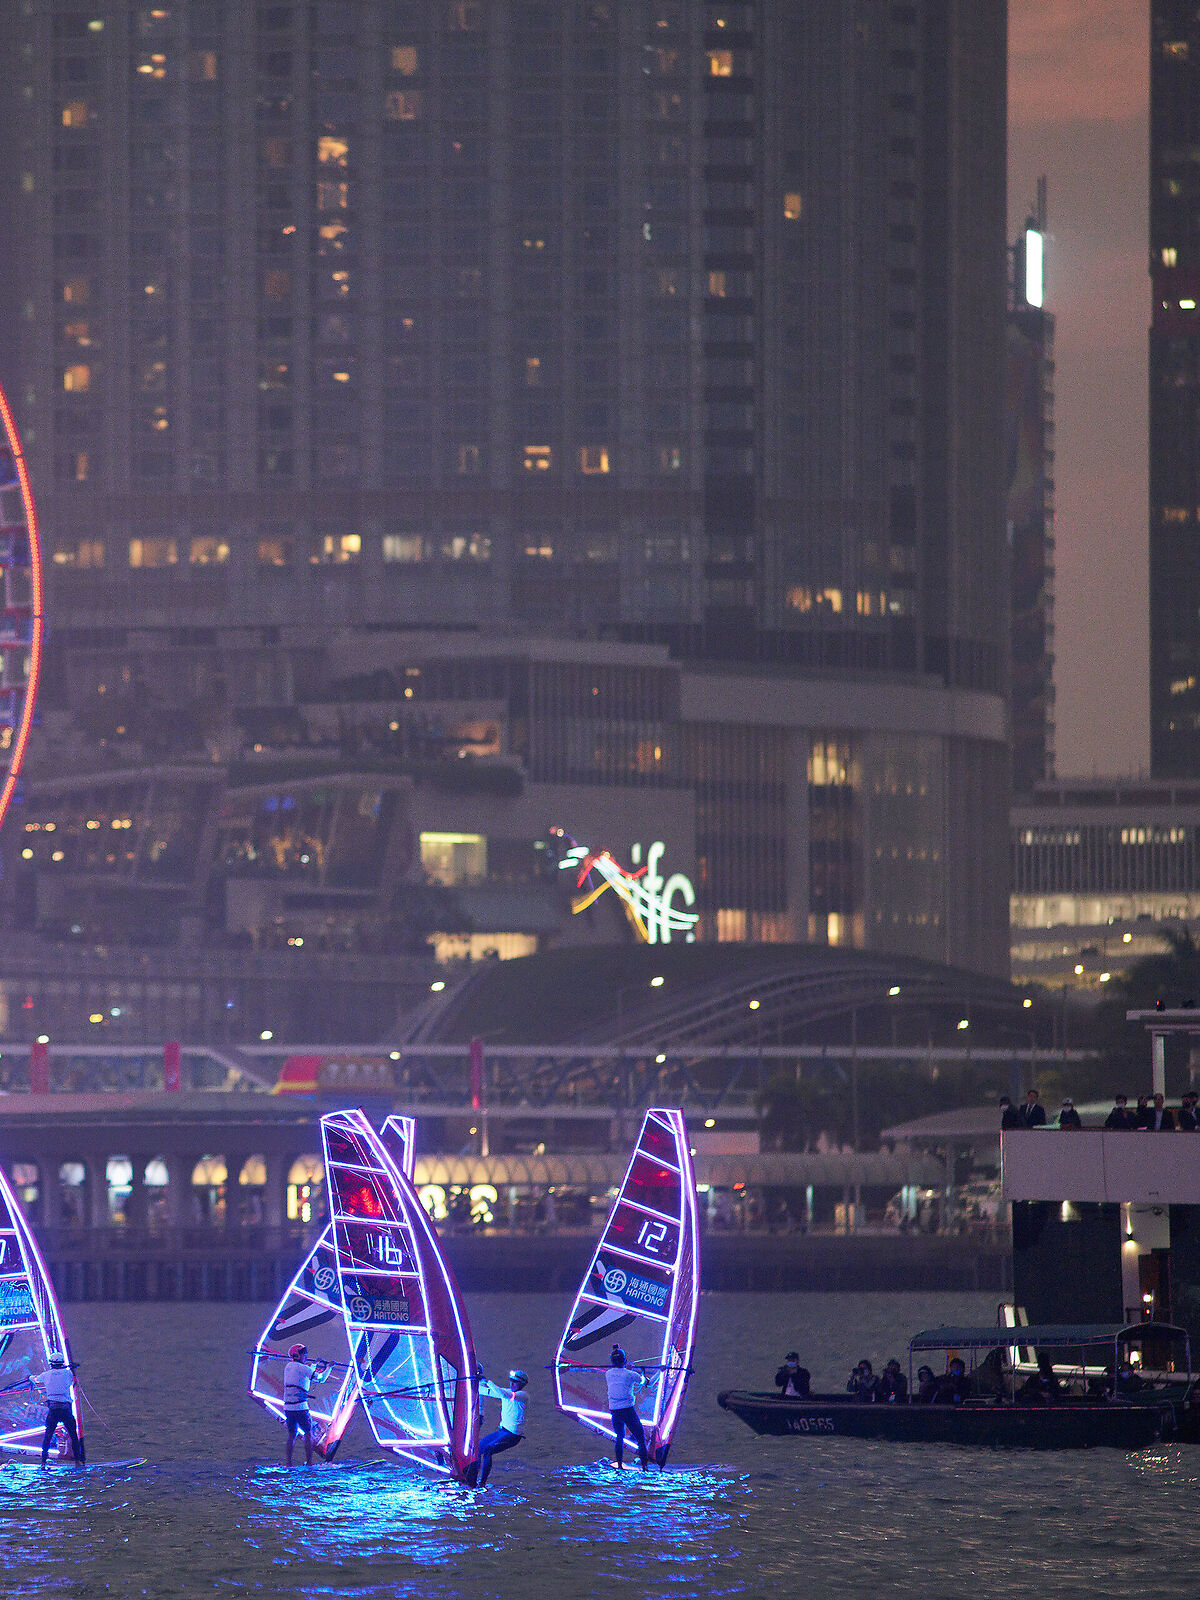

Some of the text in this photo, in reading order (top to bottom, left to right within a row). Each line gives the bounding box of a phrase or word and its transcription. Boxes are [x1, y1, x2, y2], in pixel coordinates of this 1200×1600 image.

[637, 1221, 667, 1252] 12
[379, 1235, 402, 1265] 16
[625, 1287, 663, 1306] HAITONG
[628, 1277, 668, 1299] 海通國際
[374, 1311, 409, 1321] HAITONG
